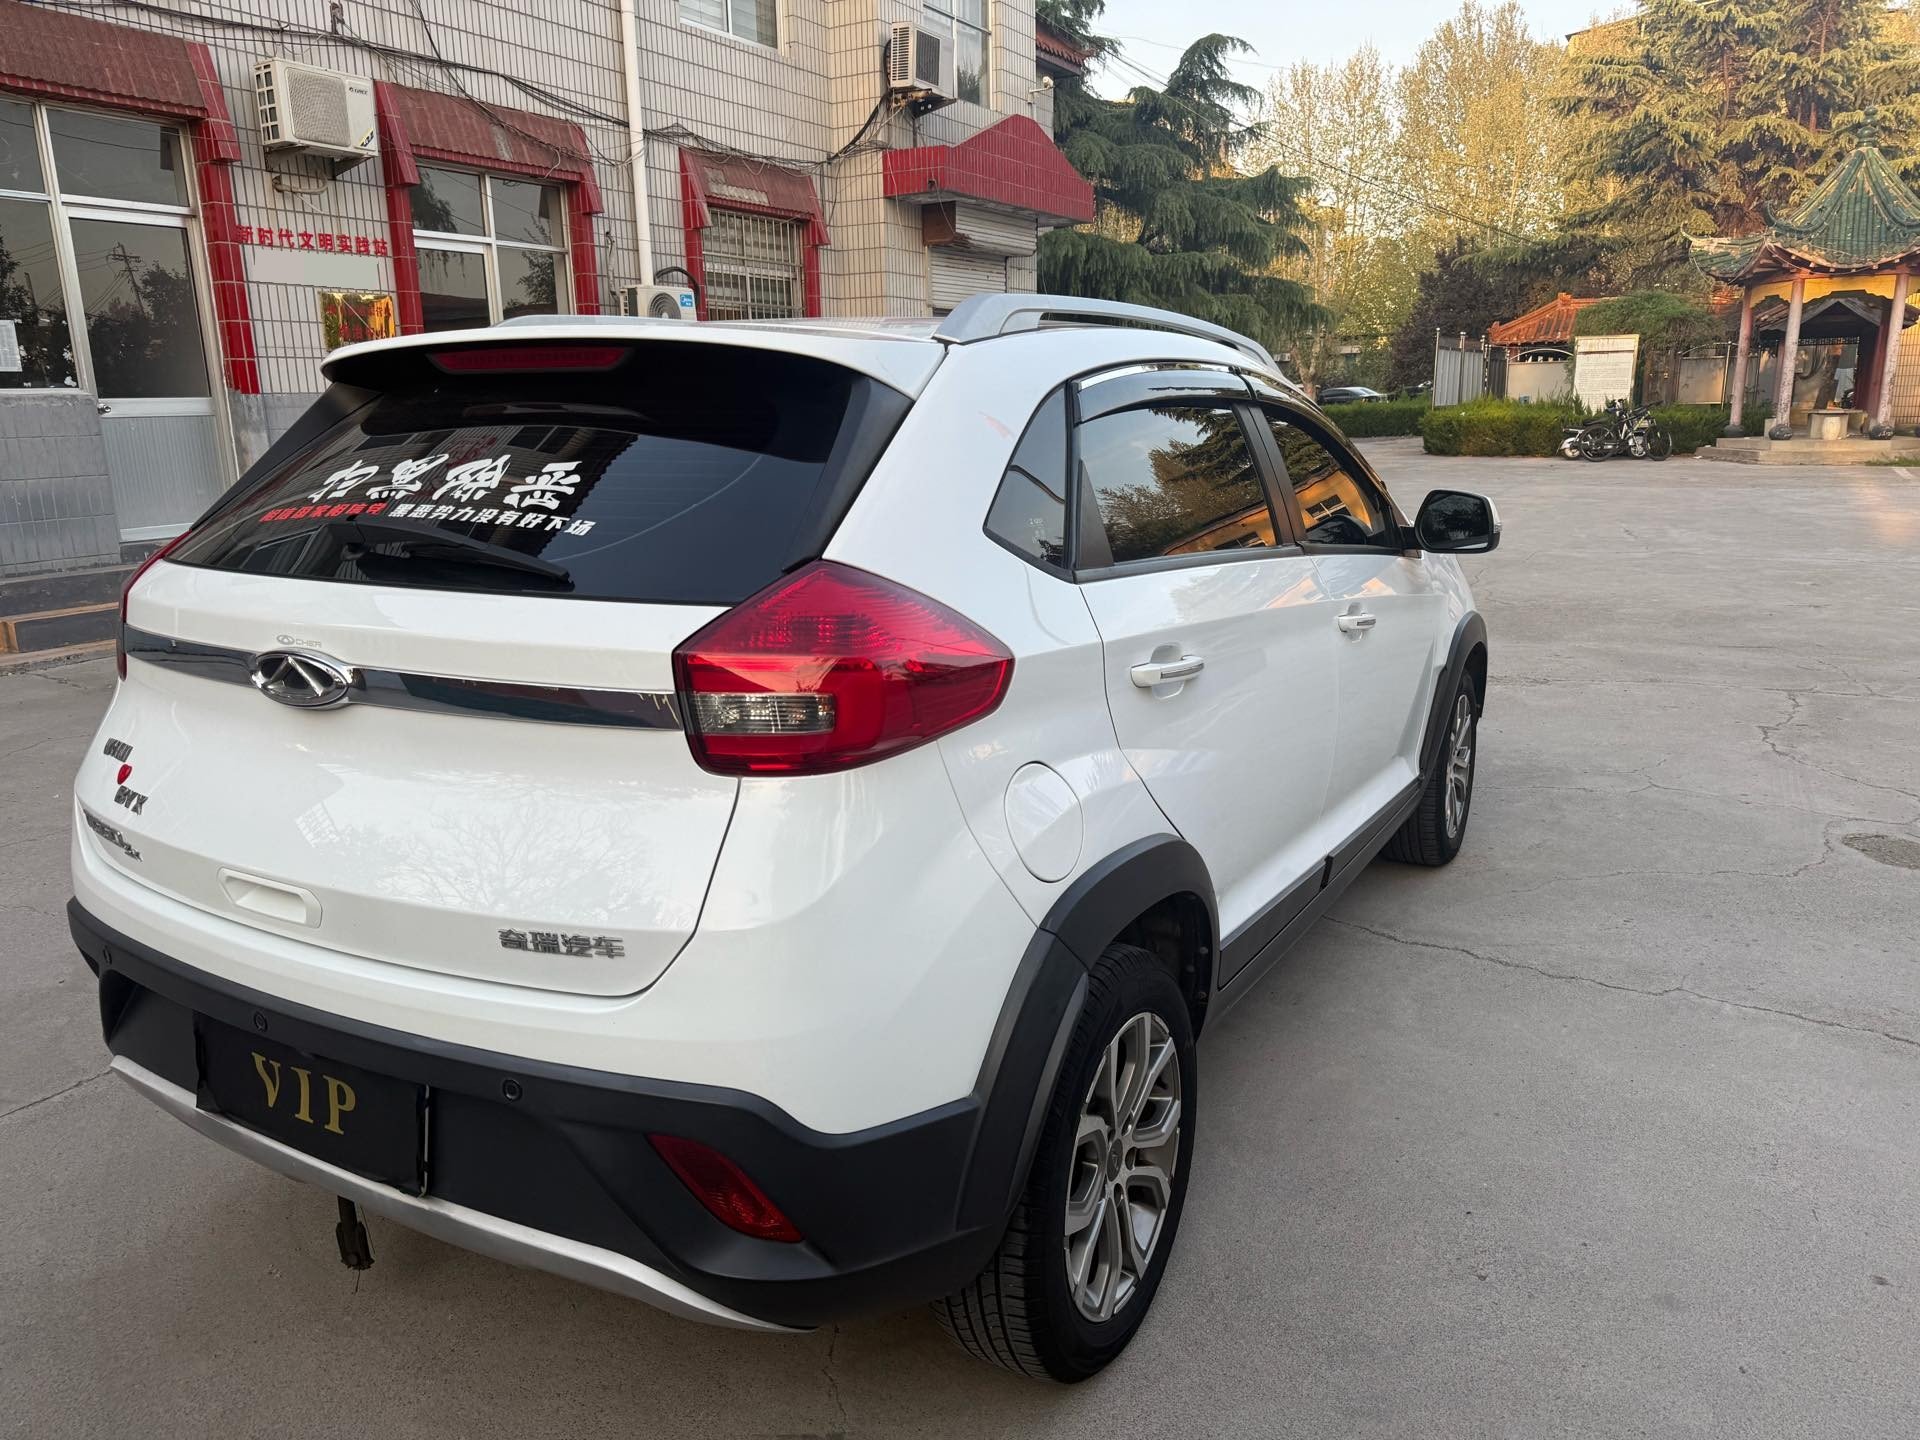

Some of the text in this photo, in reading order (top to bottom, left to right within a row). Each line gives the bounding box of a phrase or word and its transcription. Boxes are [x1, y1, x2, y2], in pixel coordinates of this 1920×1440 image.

[235, 225, 388, 257] 新时代文明实践站
[307, 453, 582, 510] 打黑除恶
[388, 503, 596, 536] 黑恶势力没有好下场
[498, 930, 626, 959] 奇瑞汽车
[251, 1051, 356, 1136] VIP
